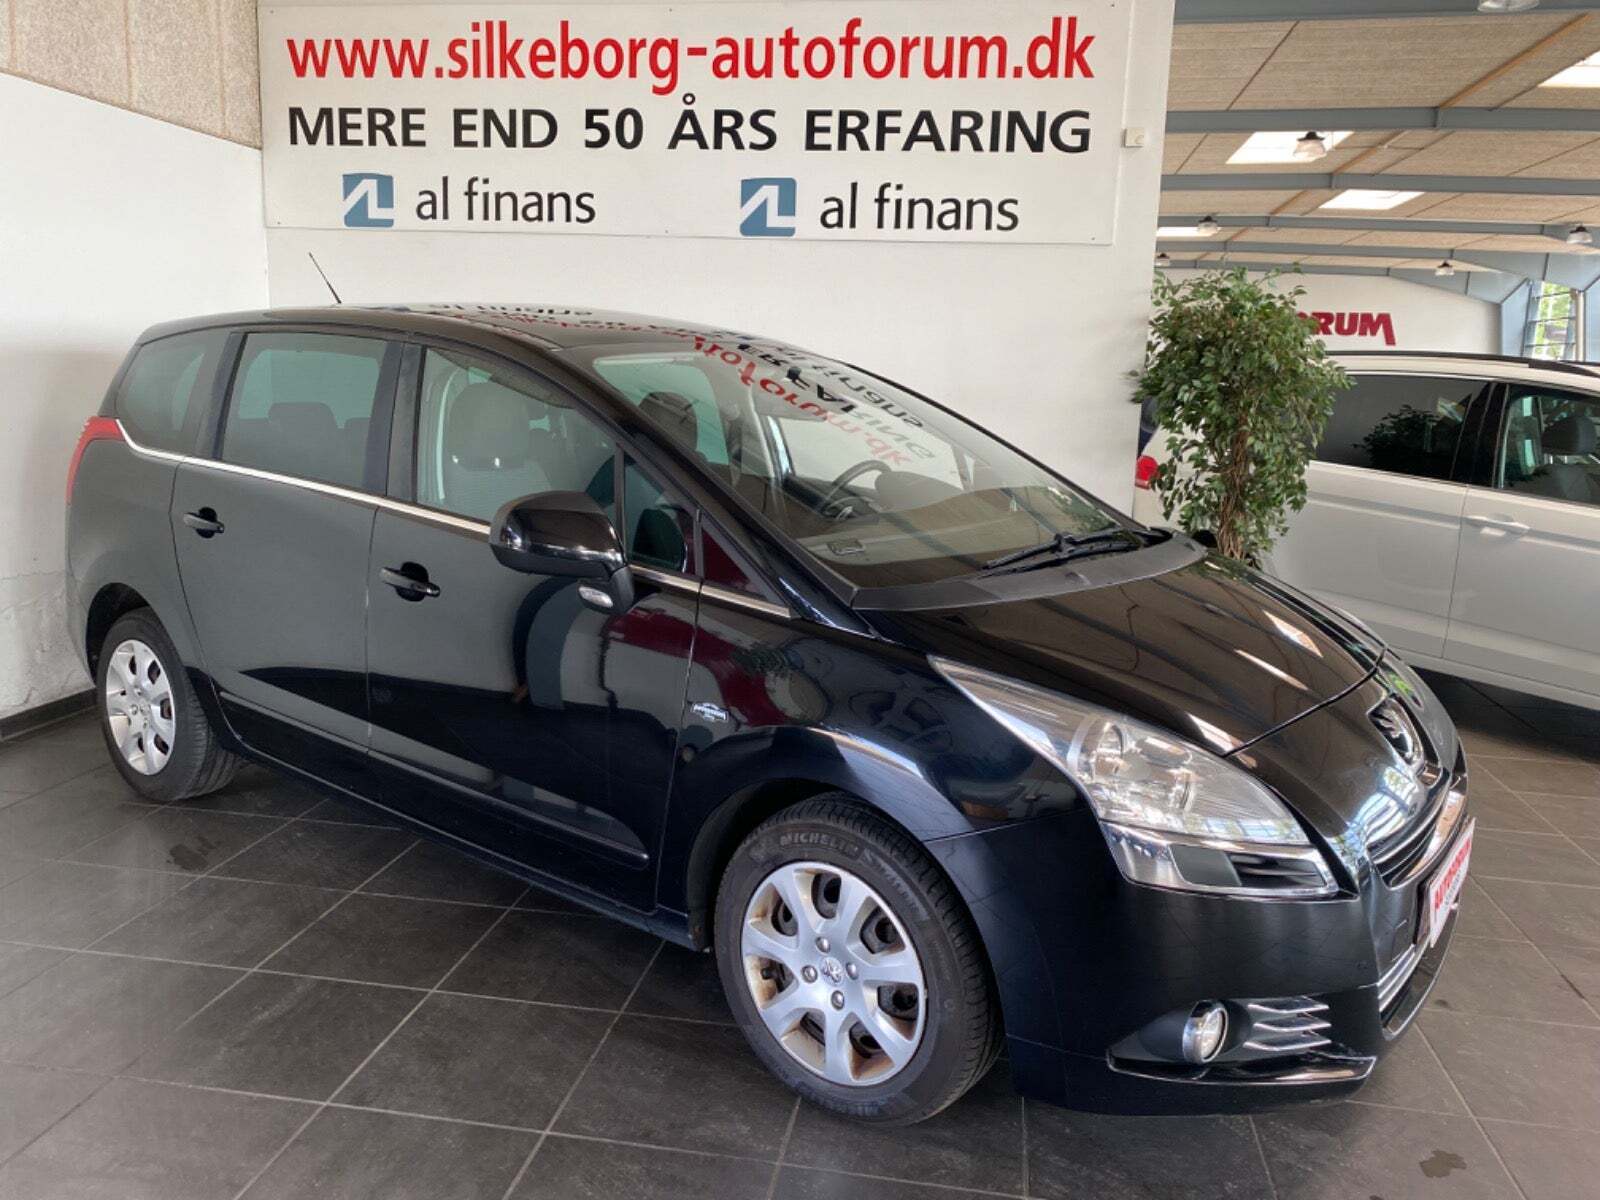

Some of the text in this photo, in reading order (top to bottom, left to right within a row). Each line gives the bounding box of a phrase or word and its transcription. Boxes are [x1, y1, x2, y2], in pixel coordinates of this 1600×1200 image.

[287, 15, 1095, 96] www.silkeborg-autoforum.dk
[288, 92, 1092, 154] MERE END 50 ÅRS ERFARING
[415, 176, 449, 221] al
[464, 176, 596, 224] finans
[819, 181, 858, 230] al
[874, 182, 1019, 232] finans
